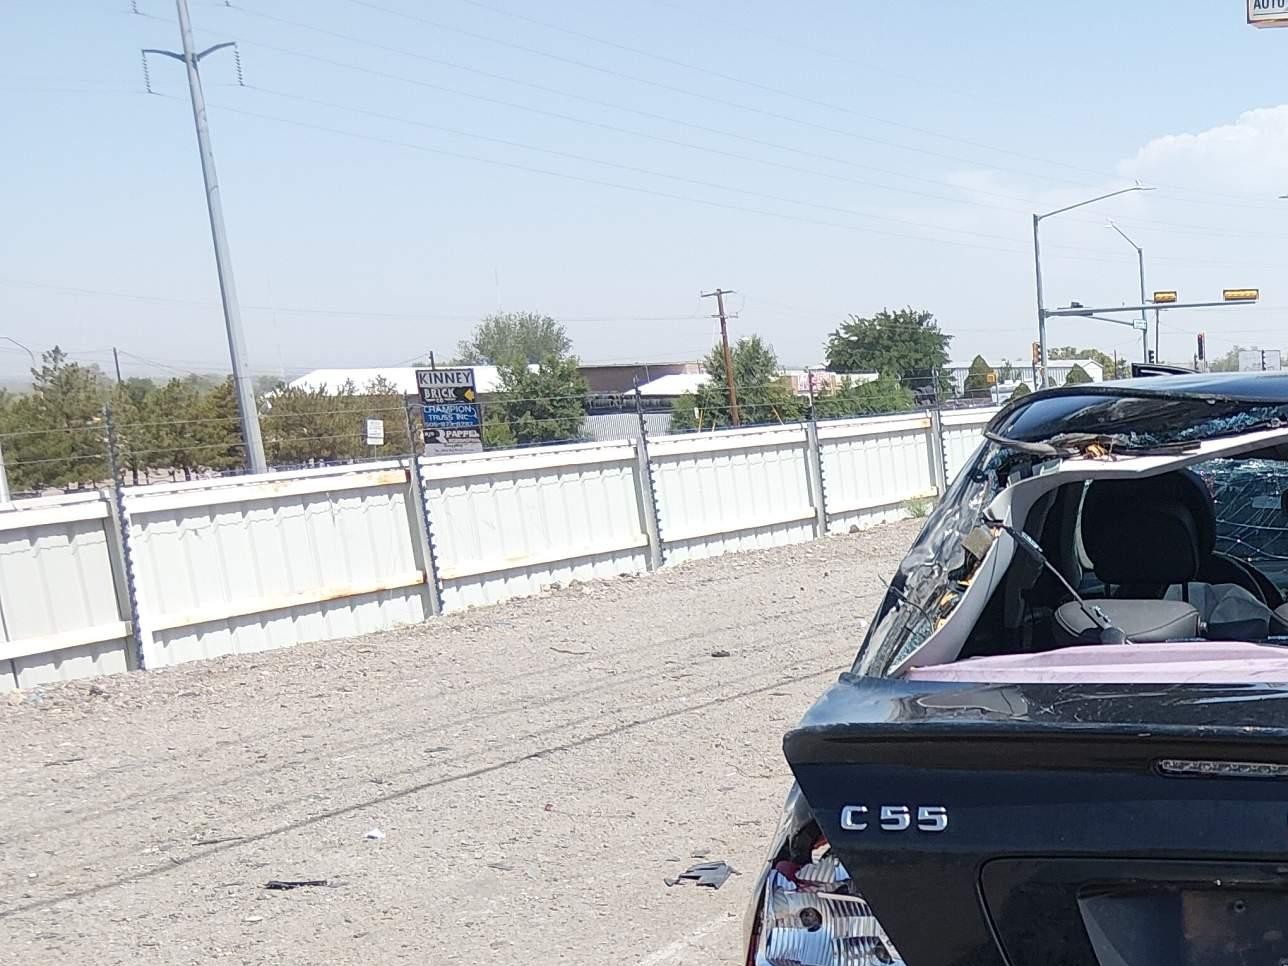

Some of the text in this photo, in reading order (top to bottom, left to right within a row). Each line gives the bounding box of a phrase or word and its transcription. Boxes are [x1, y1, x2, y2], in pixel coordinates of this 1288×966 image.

[1254, 0, 1285, 9] AUTO
[420, 372, 470, 385] KINNEY
[424, 388, 456, 399] BRICK
[424, 404, 472, 413] CHAMPION
[840, 805, 948, 831] C 55
